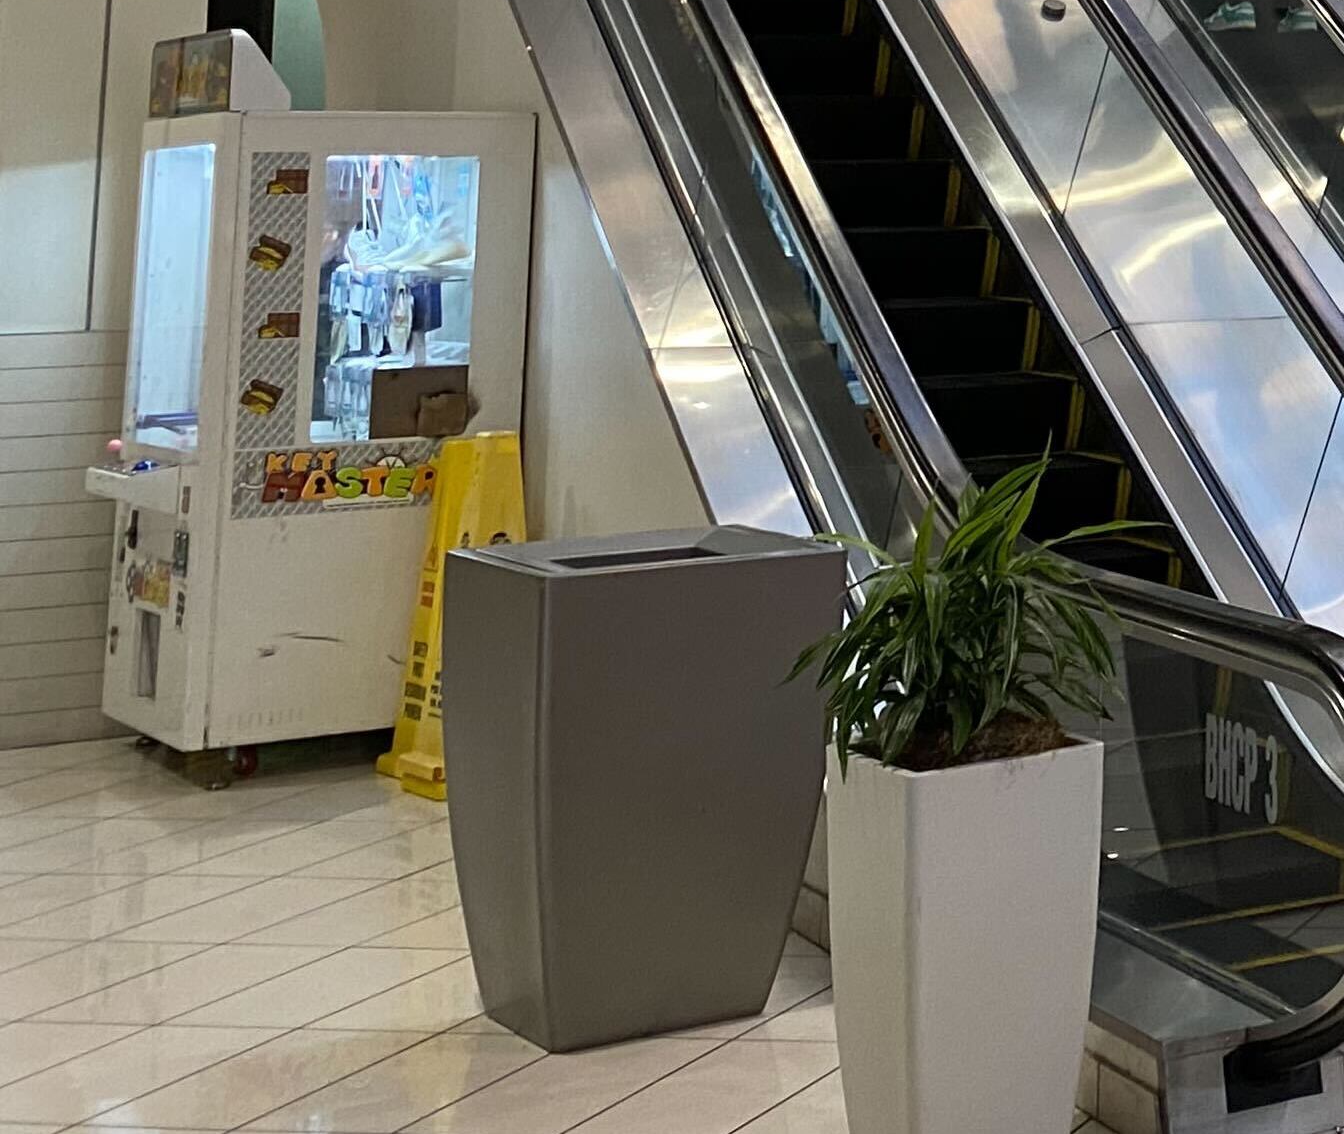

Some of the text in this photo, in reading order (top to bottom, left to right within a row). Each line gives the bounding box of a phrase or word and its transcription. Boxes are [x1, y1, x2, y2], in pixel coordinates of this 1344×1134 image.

[266, 450, 338, 473] KEY
[261, 465, 437, 504] MASTER
[1204, 712, 1279, 825] BHCP 3
